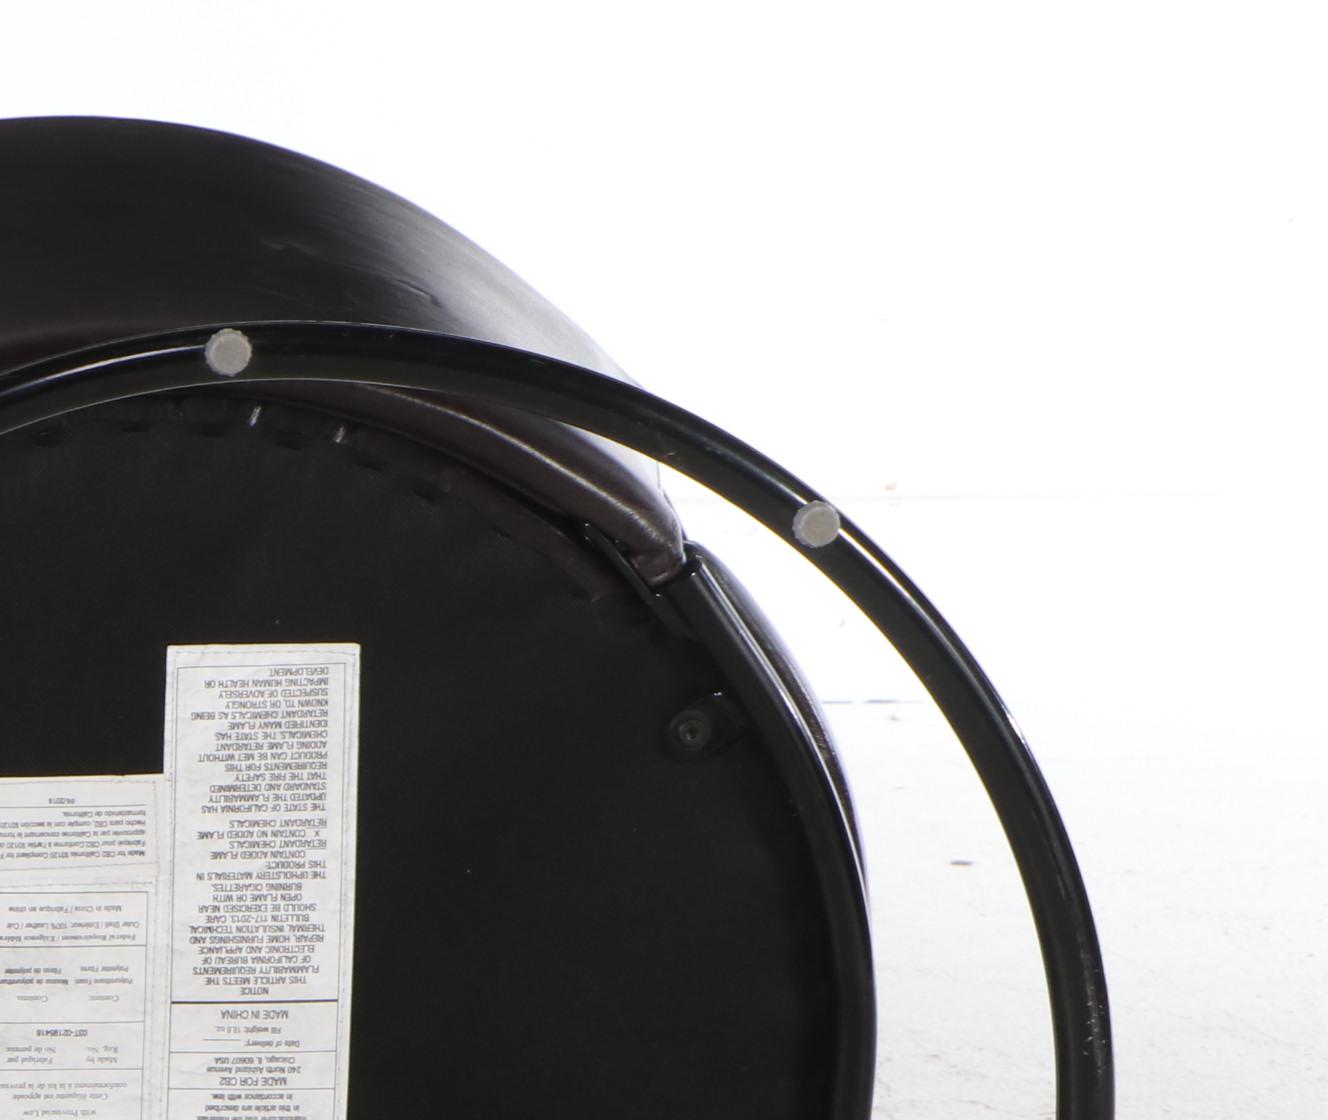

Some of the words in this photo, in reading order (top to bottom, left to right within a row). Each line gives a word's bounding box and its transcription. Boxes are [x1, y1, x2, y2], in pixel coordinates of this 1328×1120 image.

[266, 883, 302, 891] BURNING
[236, 894, 248, 902] OR
[250, 894, 279, 902] FLAME
[199, 905, 221, 913] NEAR
[271, 904, 282, 912] BE
[283, 904, 316, 912] SHOULD
[205, 915, 228, 923] CARE
[271, 914, 309, 922] BULLETIN
[236, 925, 285, 933] INSULATION
[189, 936, 207, 944] AND
[267, 935, 291, 943] HOME
[198, 946, 244, 954] APPLIANCE
[266, 945, 314, 953] ELECTRONIC
[251, 956, 299, 964] CALIFORNIA
[193, 966, 257, 974] REQUIREMENTS
[260, 965, 319, 973] FLAMMABILITY
[205, 977, 220, 985] THE
[223, 977, 251, 985] MEETS
[221, 1011, 249, 1019] CHINA
[251, 1010, 261, 1019] IN
[263, 1010, 288, 1018] MADE
